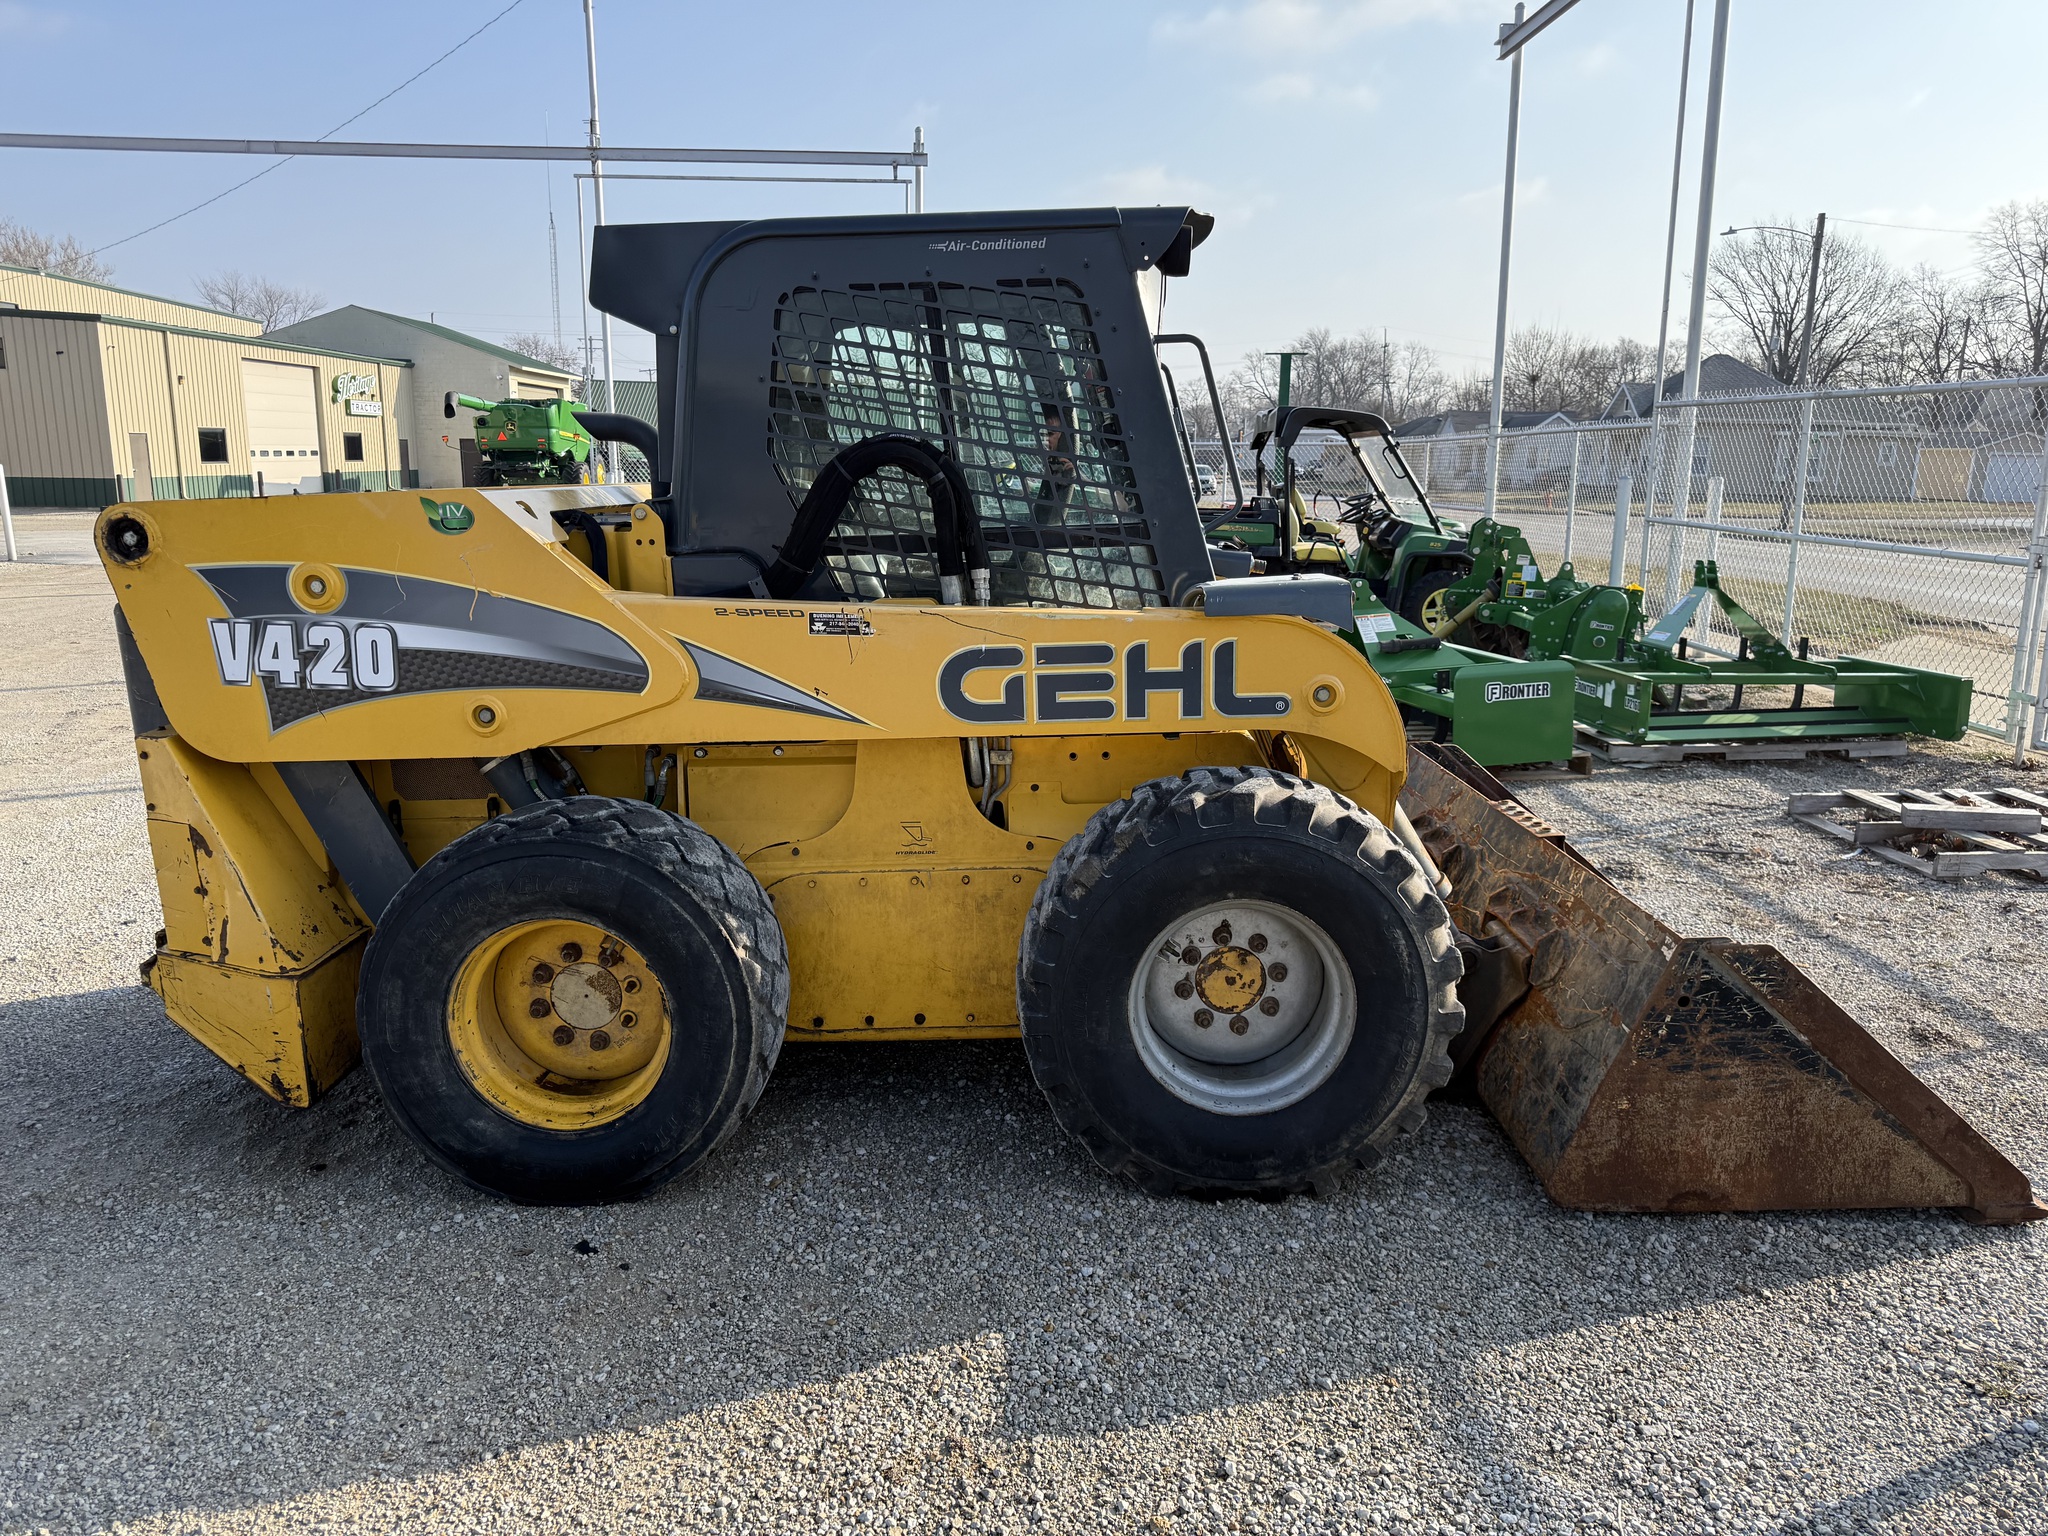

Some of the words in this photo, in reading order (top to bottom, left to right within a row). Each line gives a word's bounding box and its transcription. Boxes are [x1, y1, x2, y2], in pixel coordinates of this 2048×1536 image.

[947, 237, 1047, 252] Air-Conditioned
[336, 371, 376, 403] Heritage
[713, 608, 805, 618] 2-SPEED
[206, 617, 400, 692] V420
[936, 637, 1293, 725] GEHL
[1485, 682, 1550, 702] FRONTIER
